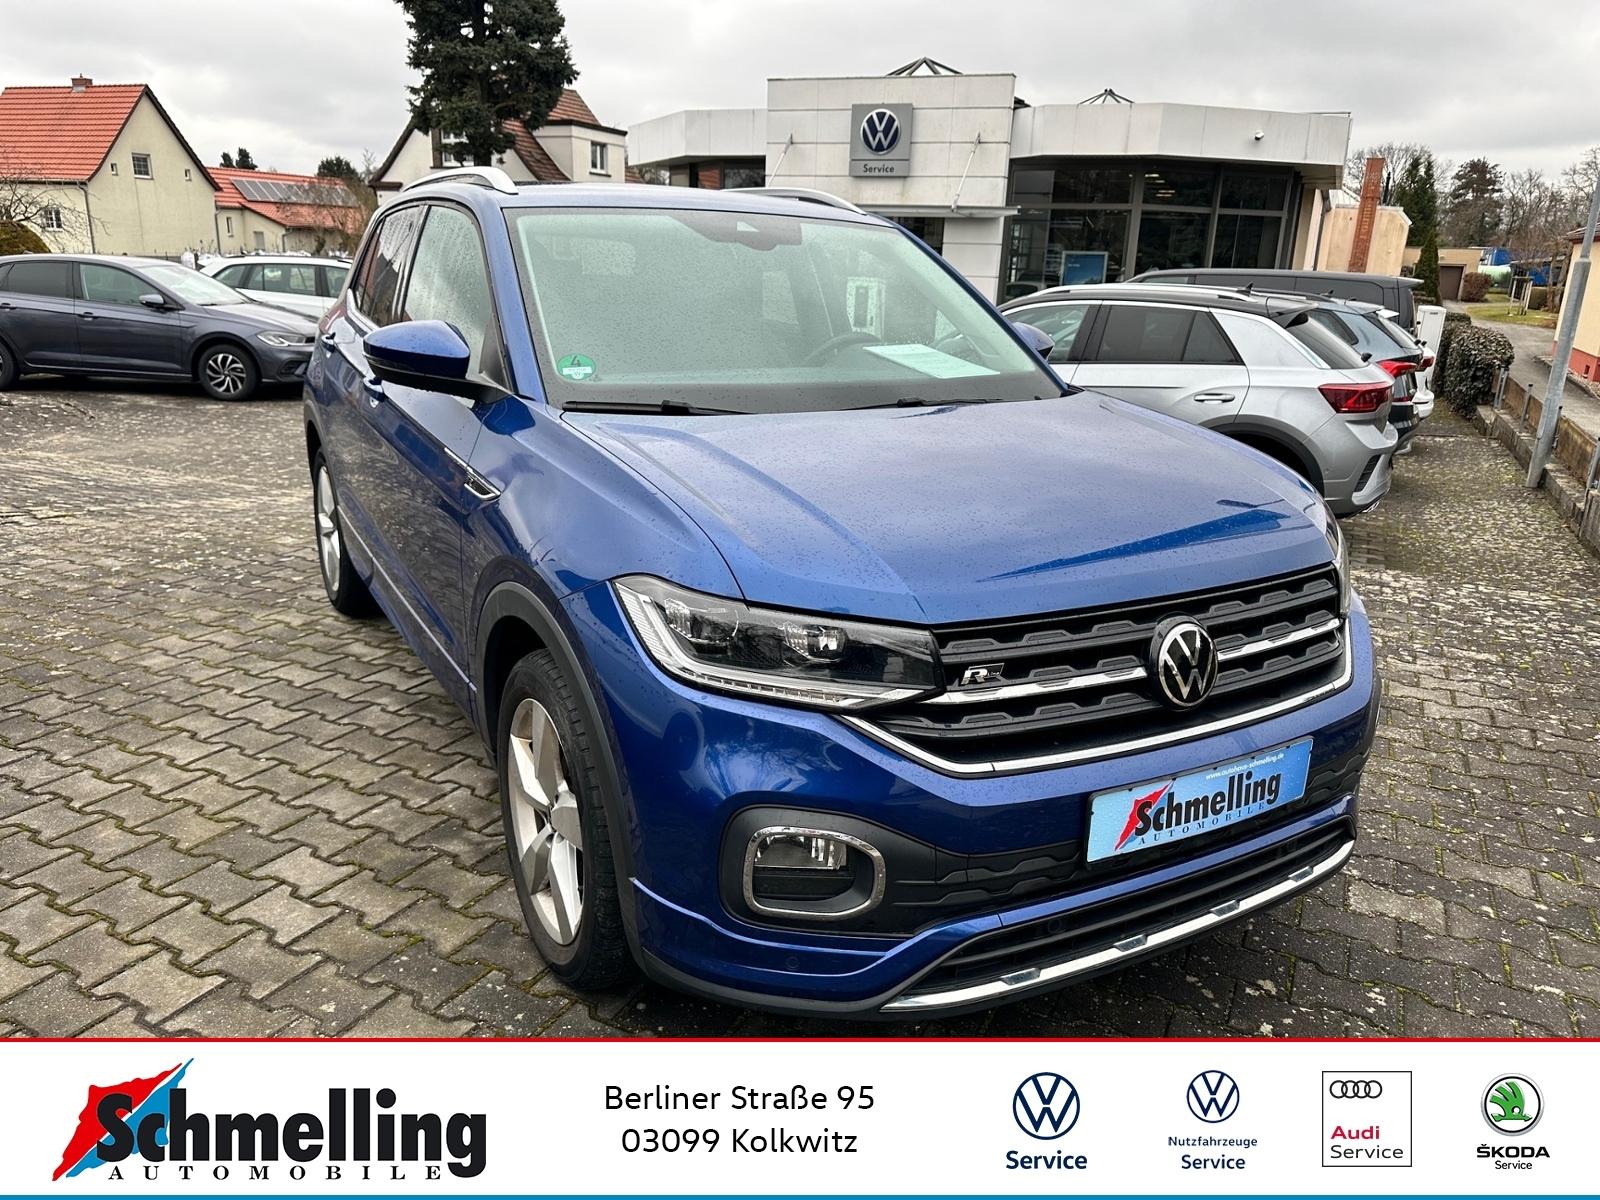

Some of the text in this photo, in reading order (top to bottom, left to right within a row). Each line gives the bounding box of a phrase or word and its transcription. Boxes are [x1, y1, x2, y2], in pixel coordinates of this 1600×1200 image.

[863, 163, 895, 173] Service
[570, 355, 581, 368] 4
[1134, 771, 1281, 837] Schmelling
[1138, 801, 1266, 846] AUTOMOBILE
